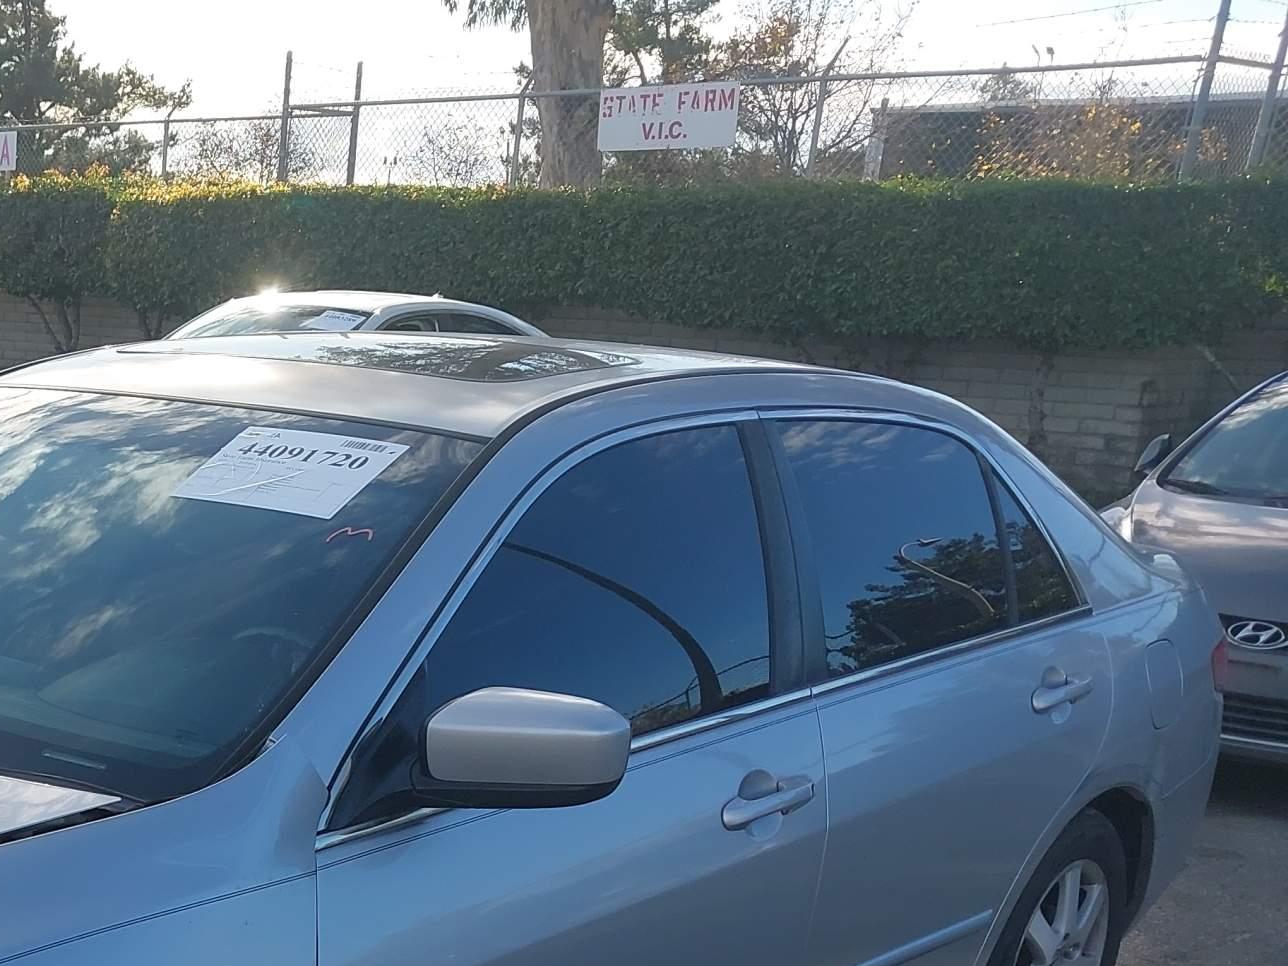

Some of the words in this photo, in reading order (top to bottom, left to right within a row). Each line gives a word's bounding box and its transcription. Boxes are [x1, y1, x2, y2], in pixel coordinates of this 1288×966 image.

[602, 93, 664, 118] STATE
[678, 88, 736, 113] FARM
[642, 121, 688, 140] V.I.C.
[0, 135, 10, 166] A
[238, 441, 370, 471] 44091720
